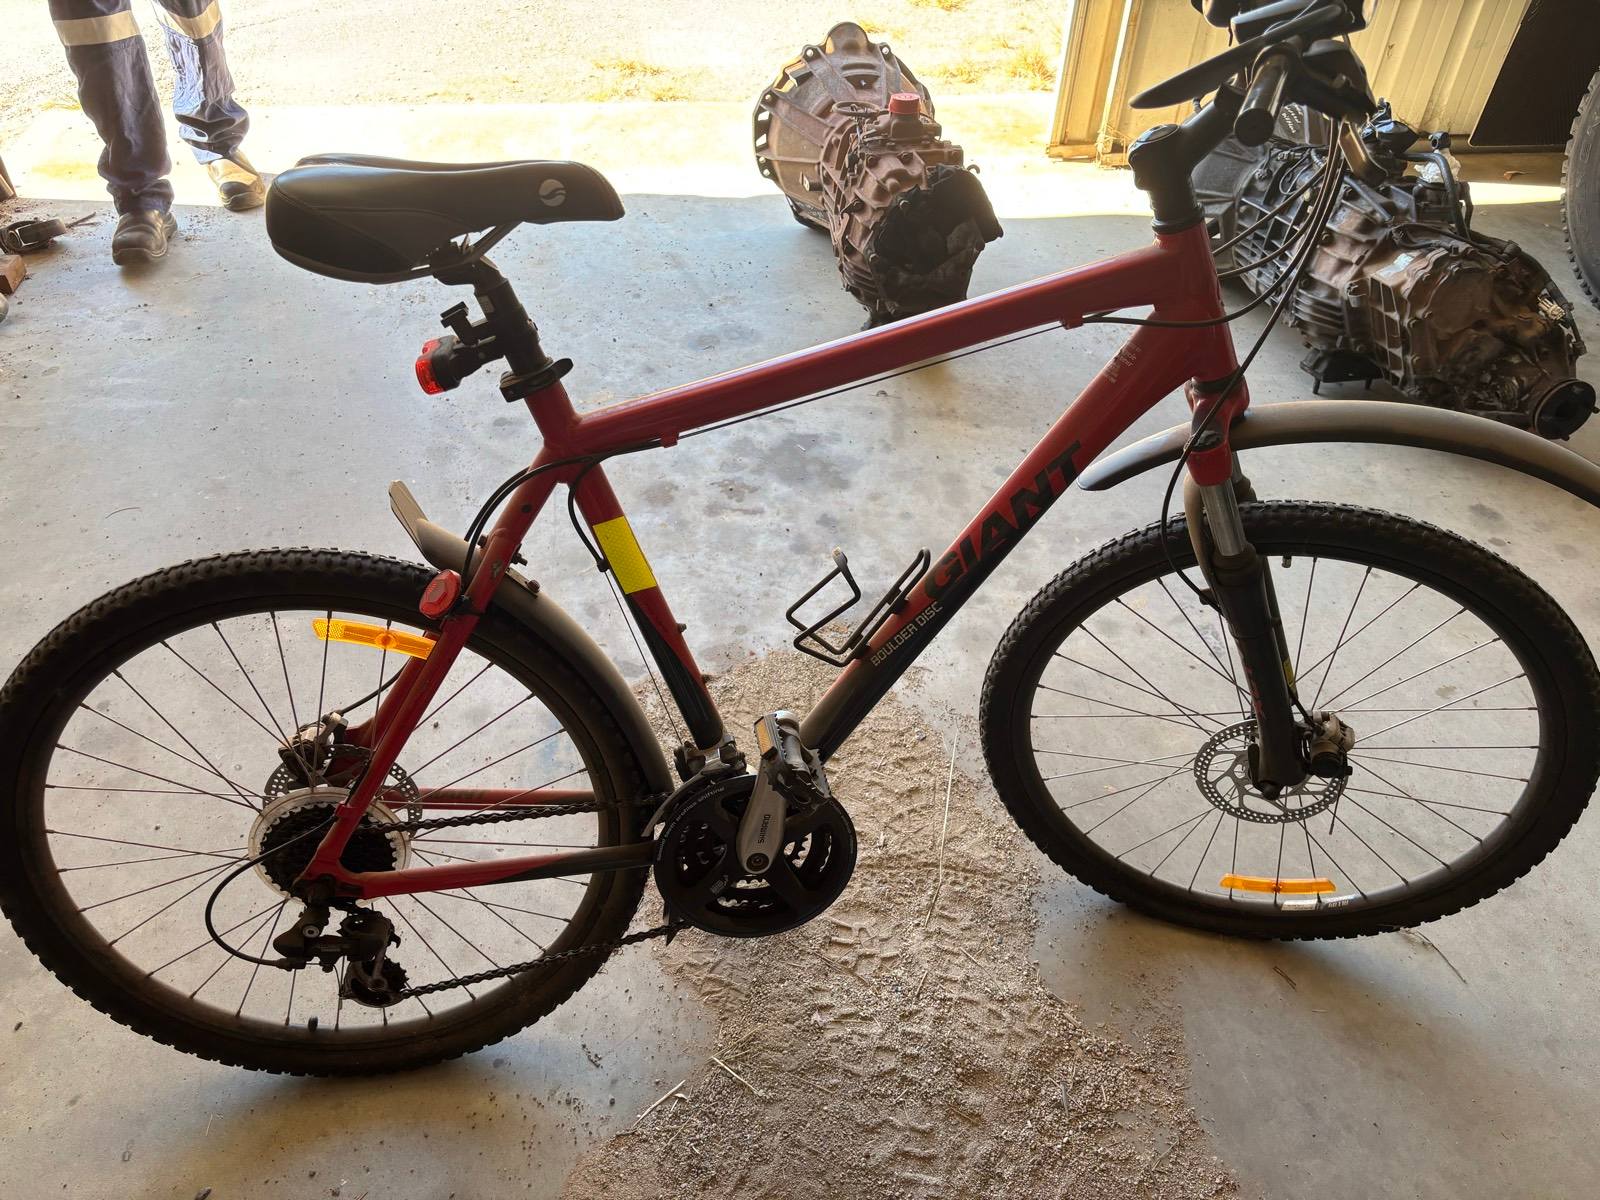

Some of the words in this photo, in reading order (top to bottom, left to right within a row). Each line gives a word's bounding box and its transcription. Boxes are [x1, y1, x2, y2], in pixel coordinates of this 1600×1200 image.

[923, 440, 1082, 602] GIANT
[870, 622, 919, 667] BOULDER
[914, 600, 944, 628] DISC
